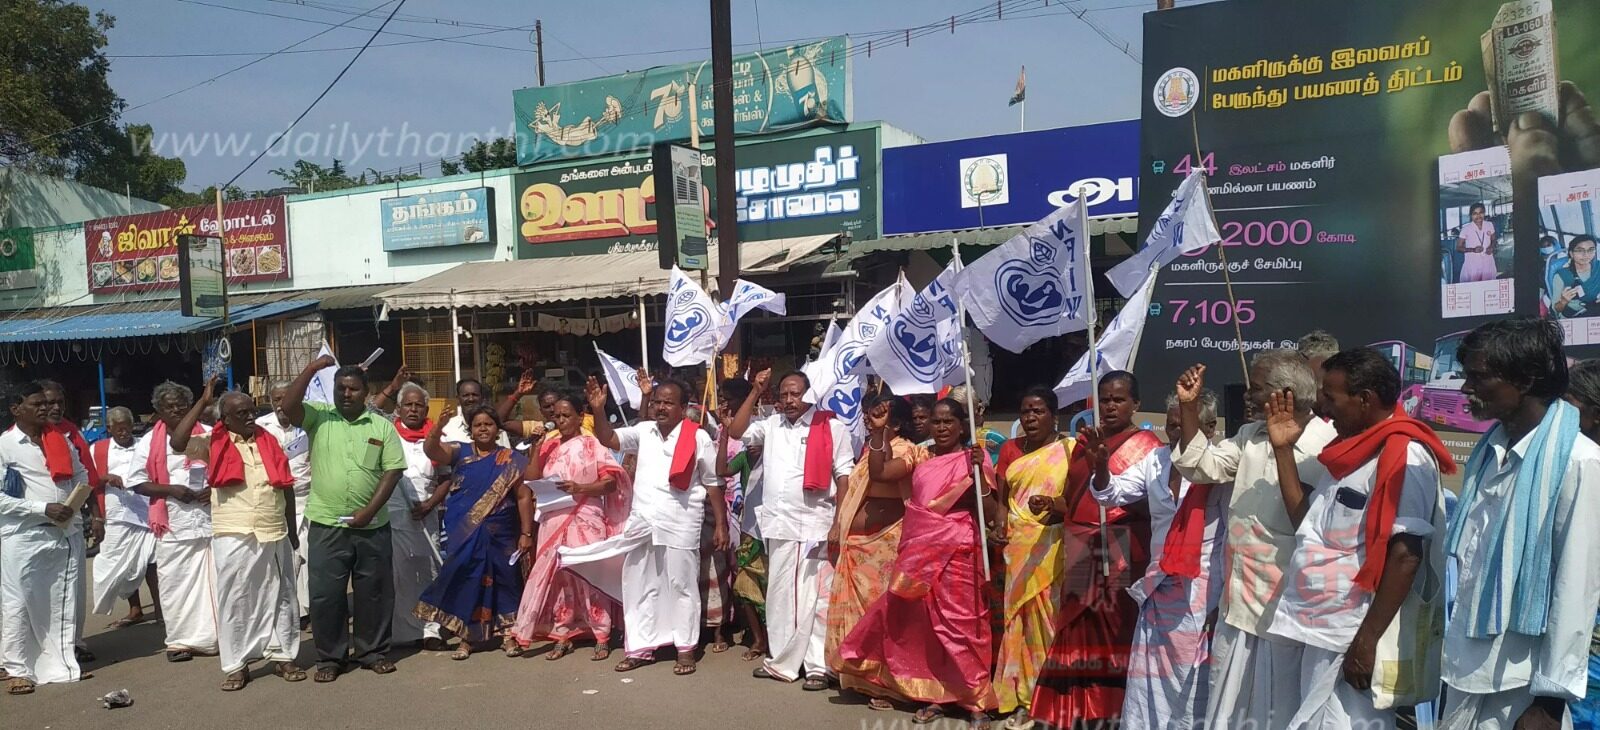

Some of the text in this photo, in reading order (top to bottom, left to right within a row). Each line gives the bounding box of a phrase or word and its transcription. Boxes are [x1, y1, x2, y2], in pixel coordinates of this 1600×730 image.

[1211, 35, 1430, 83] மகளிருக்கு இலவசப்
[1212, 85, 1288, 110] பேருந்து
[1294, 71, 1379, 102] பயணத்
[1387, 60, 1463, 94] திட்டம்
[559, 168, 609, 184] தங்களை
[1228, 160, 1287, 176] இலட்சம்
[1290, 155, 1336, 171] மகளிர்
[1266, 178, 1317, 193] பயணம்
[391, 191, 478, 226] தங்கம்
[200, 208, 276, 233] ஹோட்டல்
[1316, 231, 1357, 245] கோடி
[1254, 256, 1303, 271] சேமிப்பு
[1168, 299, 1257, 326] 7,105
[1165, 336, 1198, 350] நகரப்
[1201, 337, 1275, 353] பேருந்துகள்
